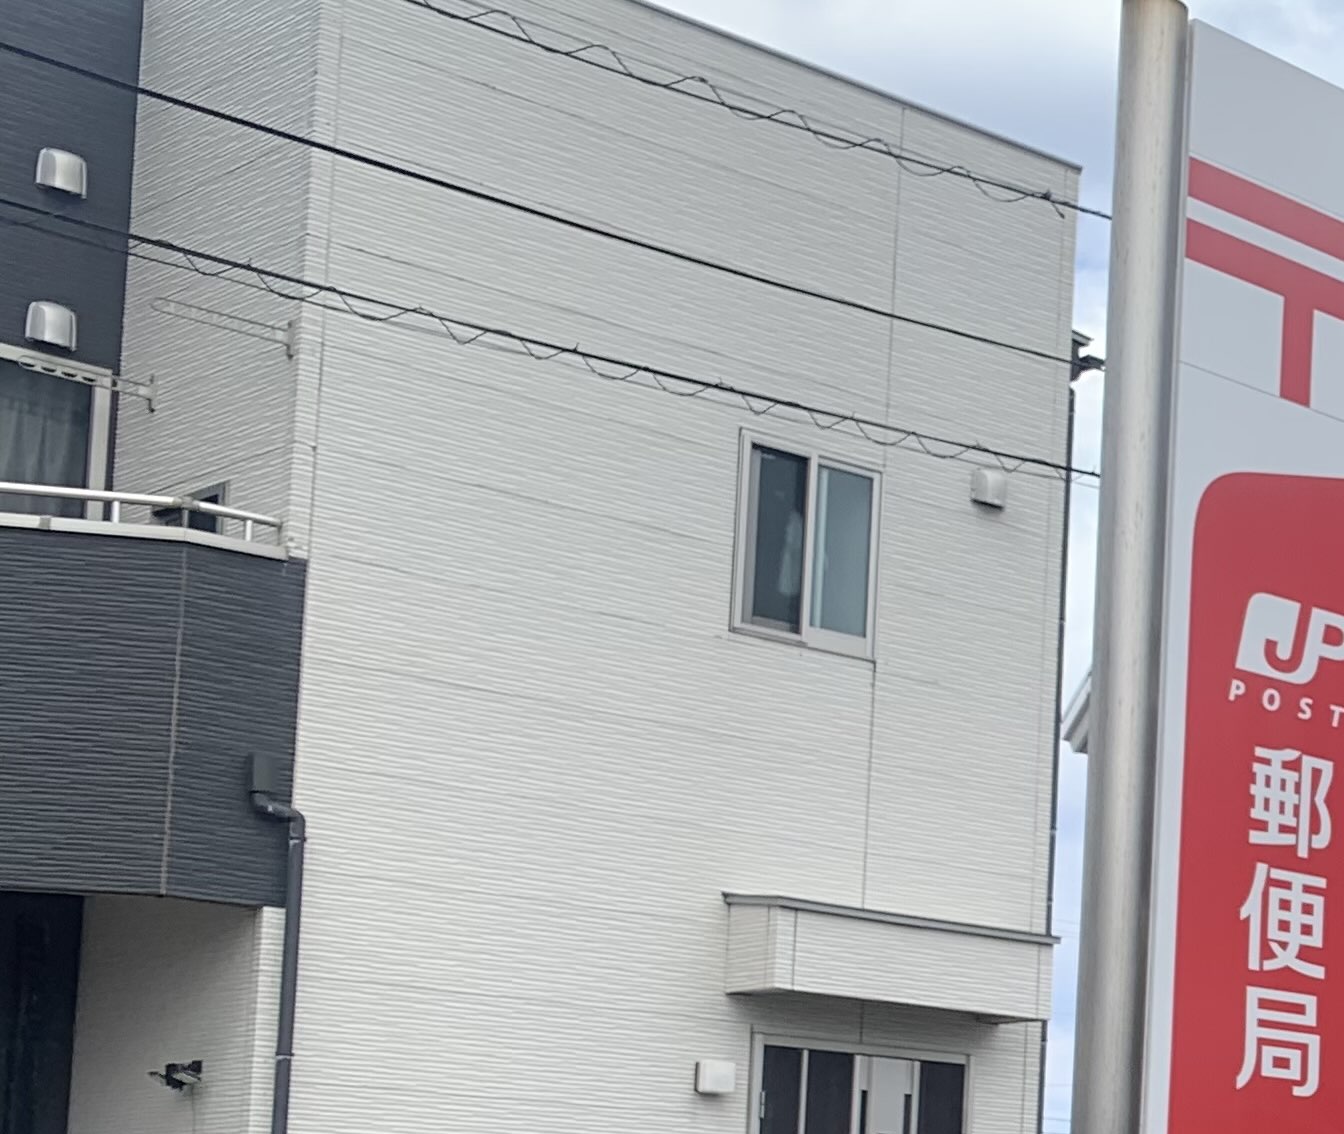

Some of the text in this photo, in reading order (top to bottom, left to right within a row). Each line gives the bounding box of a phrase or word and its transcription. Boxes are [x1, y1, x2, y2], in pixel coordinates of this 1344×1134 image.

[1228, 679, 1344, 728] POST
[1235, 745, 1334, 1097] 郵便局
